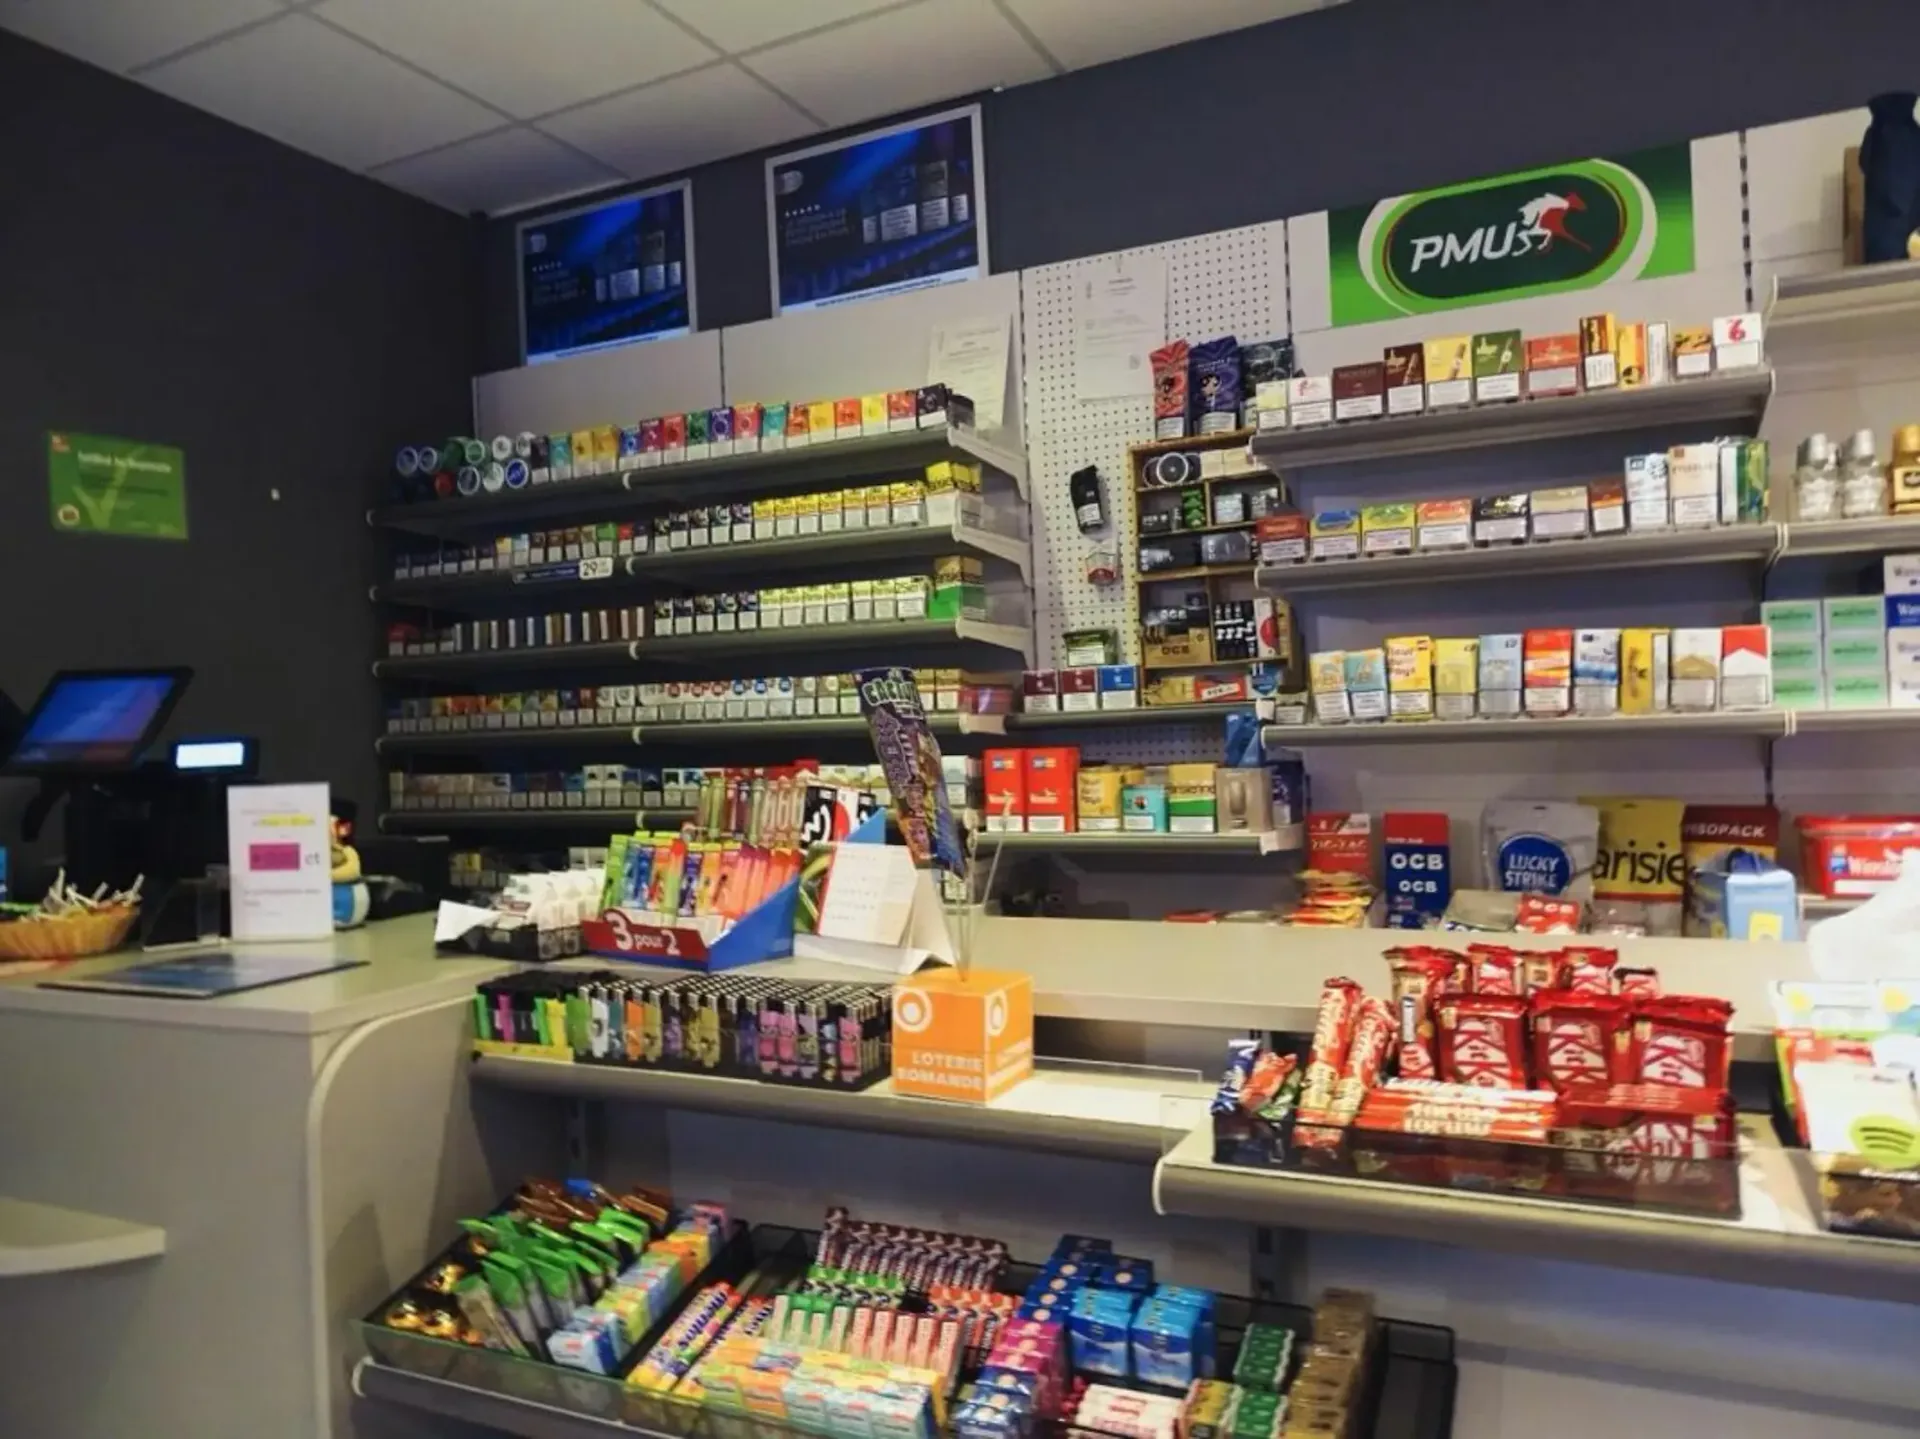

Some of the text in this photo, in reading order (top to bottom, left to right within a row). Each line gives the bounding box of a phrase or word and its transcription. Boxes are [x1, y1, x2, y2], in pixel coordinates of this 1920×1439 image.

[1410, 221, 1517, 273] PMU
[1390, 852, 1444, 870] OCB
[1509, 853, 1560, 872] LUCKY
[1398, 880, 1438, 893] OCB
[1504, 870, 1558, 889] STRIKE
[605, 911, 682, 955] 3 pour 2
[912, 1051, 984, 1073] LOTERIE
[896, 1067, 984, 1090] ROMANDE
